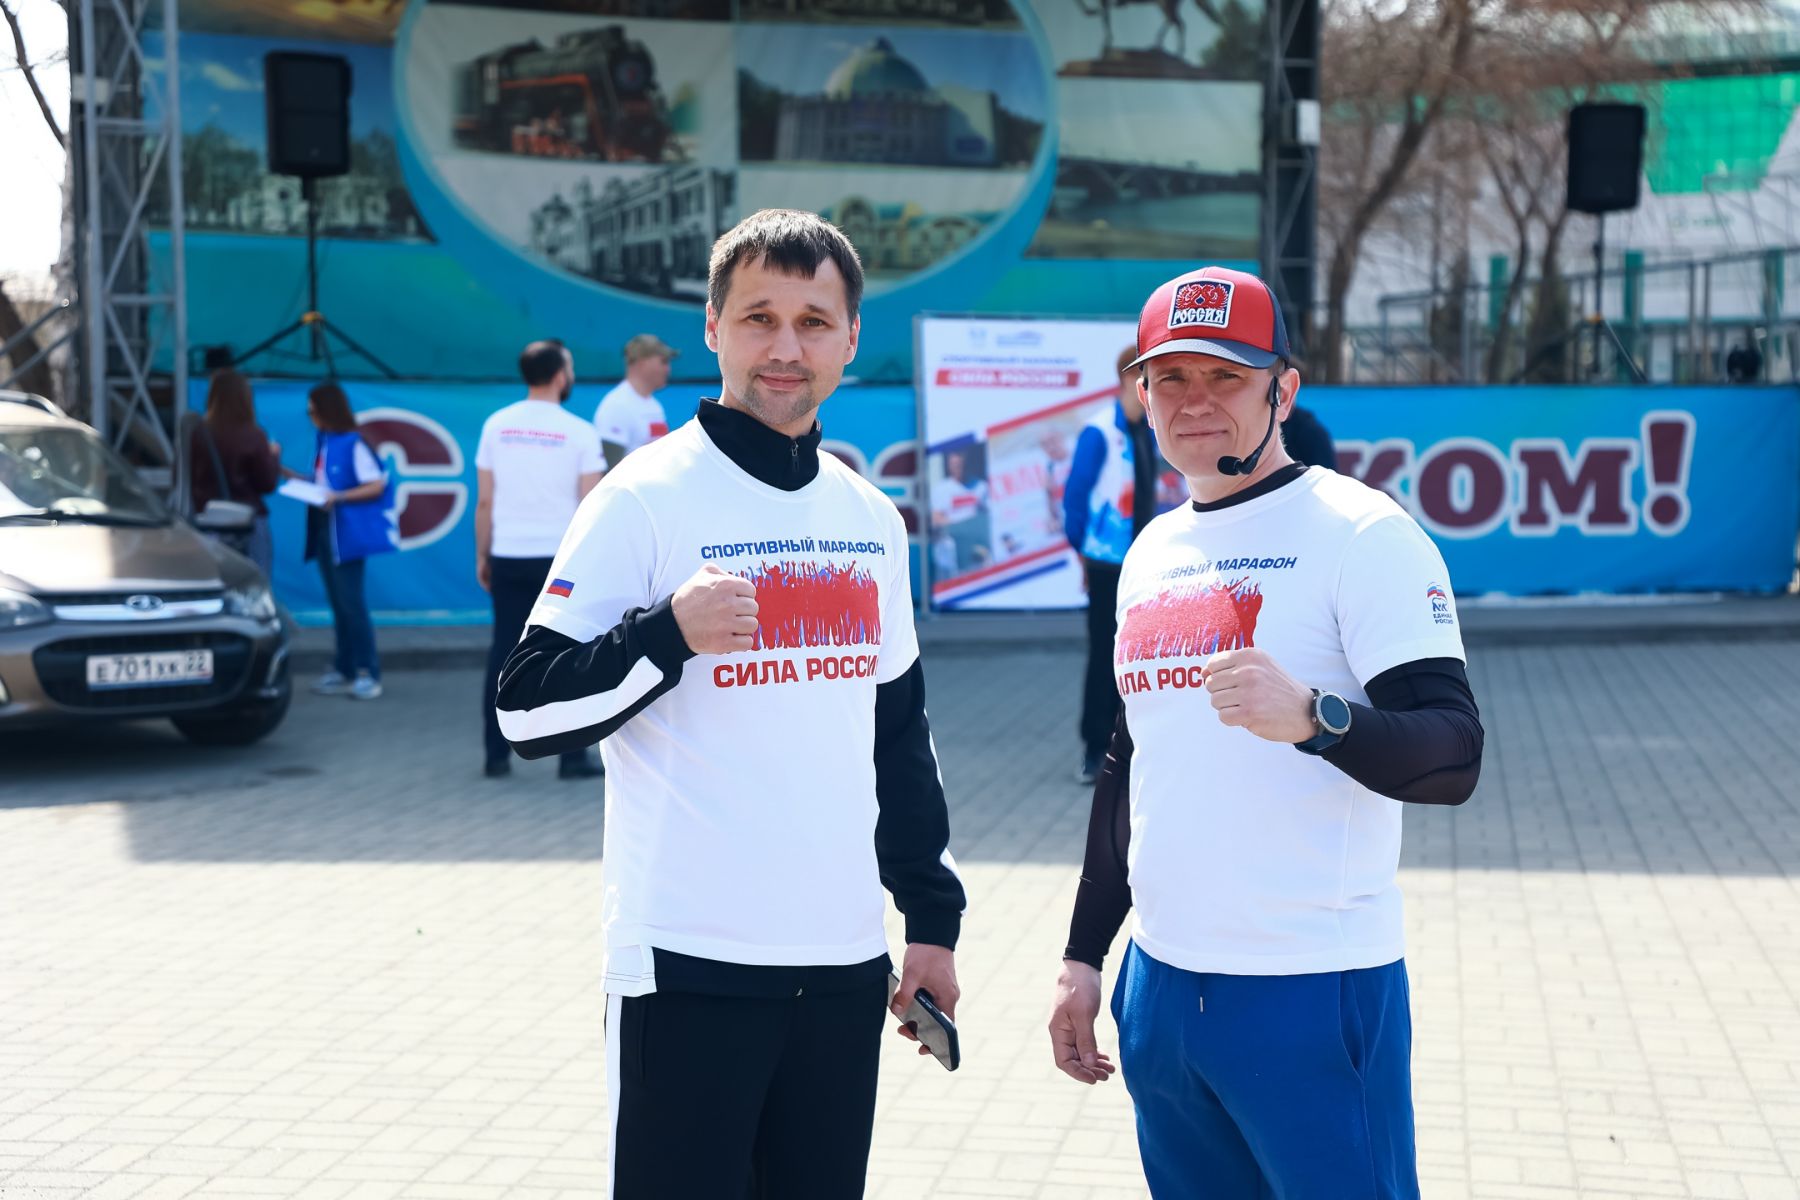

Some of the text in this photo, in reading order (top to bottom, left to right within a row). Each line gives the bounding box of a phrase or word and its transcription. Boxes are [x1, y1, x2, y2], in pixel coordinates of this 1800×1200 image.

[1172, 308, 1225, 325] РОССИЯ
[701, 537, 886, 559] СПОРТИВНЫЙ МАРАФОН
[1214, 557, 1298, 572] МАРАФОН
[713, 655, 879, 688] СИЛА РОССИ
[1157, 666, 1206, 690] РОС
